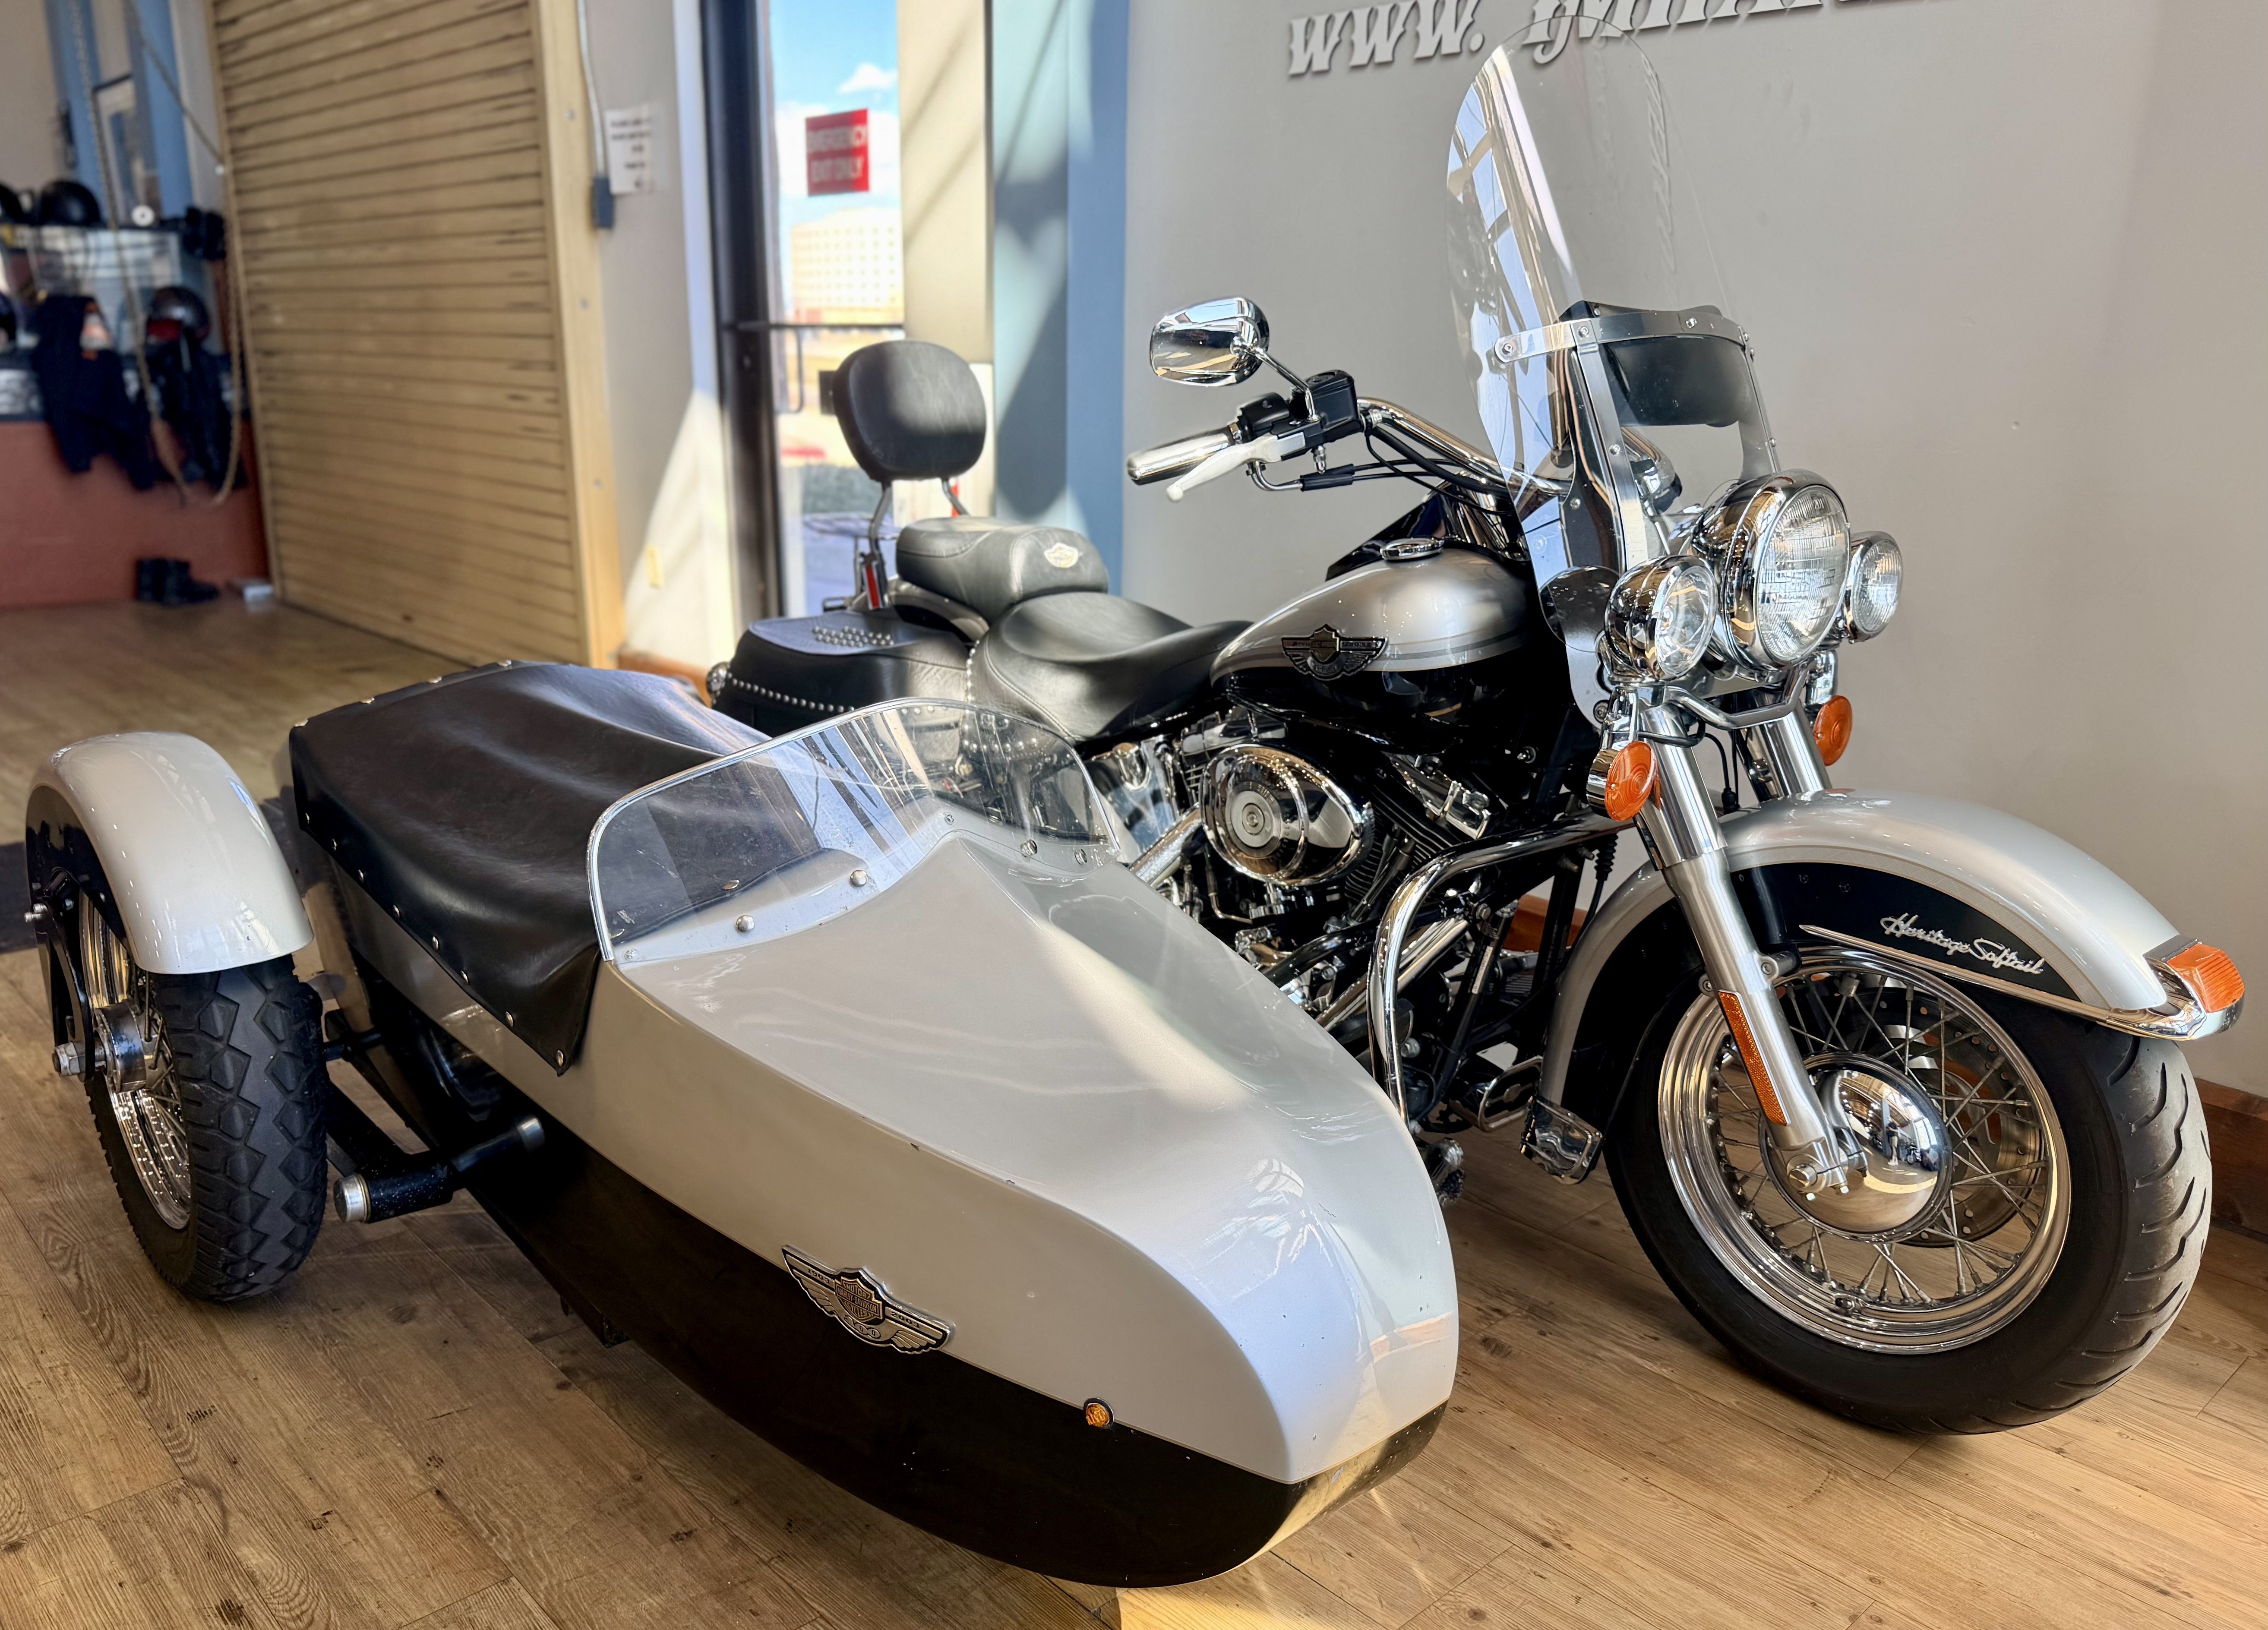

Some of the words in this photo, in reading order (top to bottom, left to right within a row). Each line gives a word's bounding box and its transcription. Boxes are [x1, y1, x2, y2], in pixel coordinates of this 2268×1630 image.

[1879, 912, 1971, 955] Heritage
[1971, 937, 2045, 975] Softail
[808, 1269, 830, 1284] 1903
[846, 1284, 867, 1298] MOTOR
[838, 1288, 877, 1313] HARLEY-DAVIDSON
[891, 1311, 920, 1328] 2003
